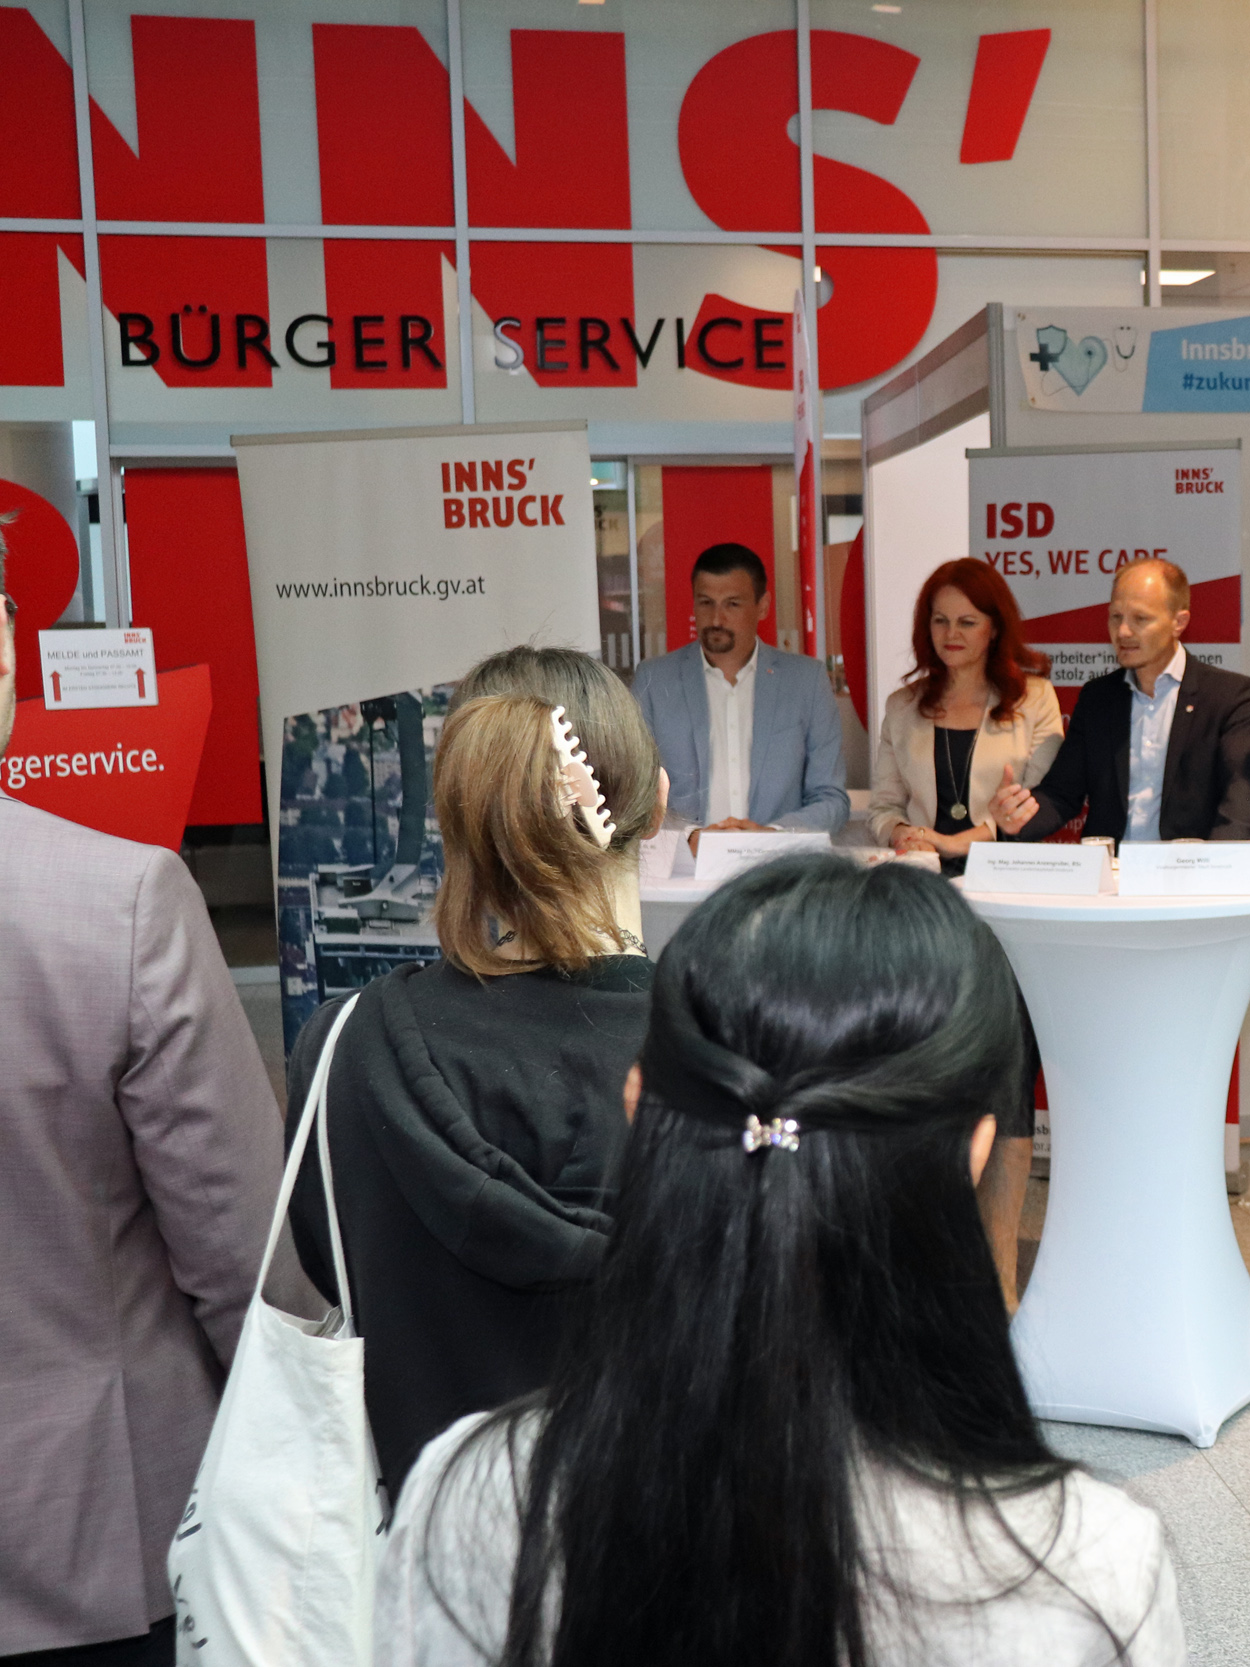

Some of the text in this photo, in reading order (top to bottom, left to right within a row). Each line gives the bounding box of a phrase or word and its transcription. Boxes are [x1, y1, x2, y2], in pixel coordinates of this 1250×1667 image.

[118, 304, 444, 371] BÜRGER
[493, 316, 788, 373] SERVICE
[440, 458, 536, 494] INNS'
[1175, 467, 1214, 481] INNS'
[1175, 481, 1225, 495] BRUCK
[442, 494, 566, 530] BRUCK
[986, 502, 1055, 539] ISD
[984, 550, 1041, 580] YES,
[1047, 549, 1090, 575] WE
[275, 574, 486, 602] www.innsbruck.gv.at
[47, 650, 78, 660] MELDE
[100, 648, 144, 658] PASSAMT
[1055, 667, 1085, 681] stolz
